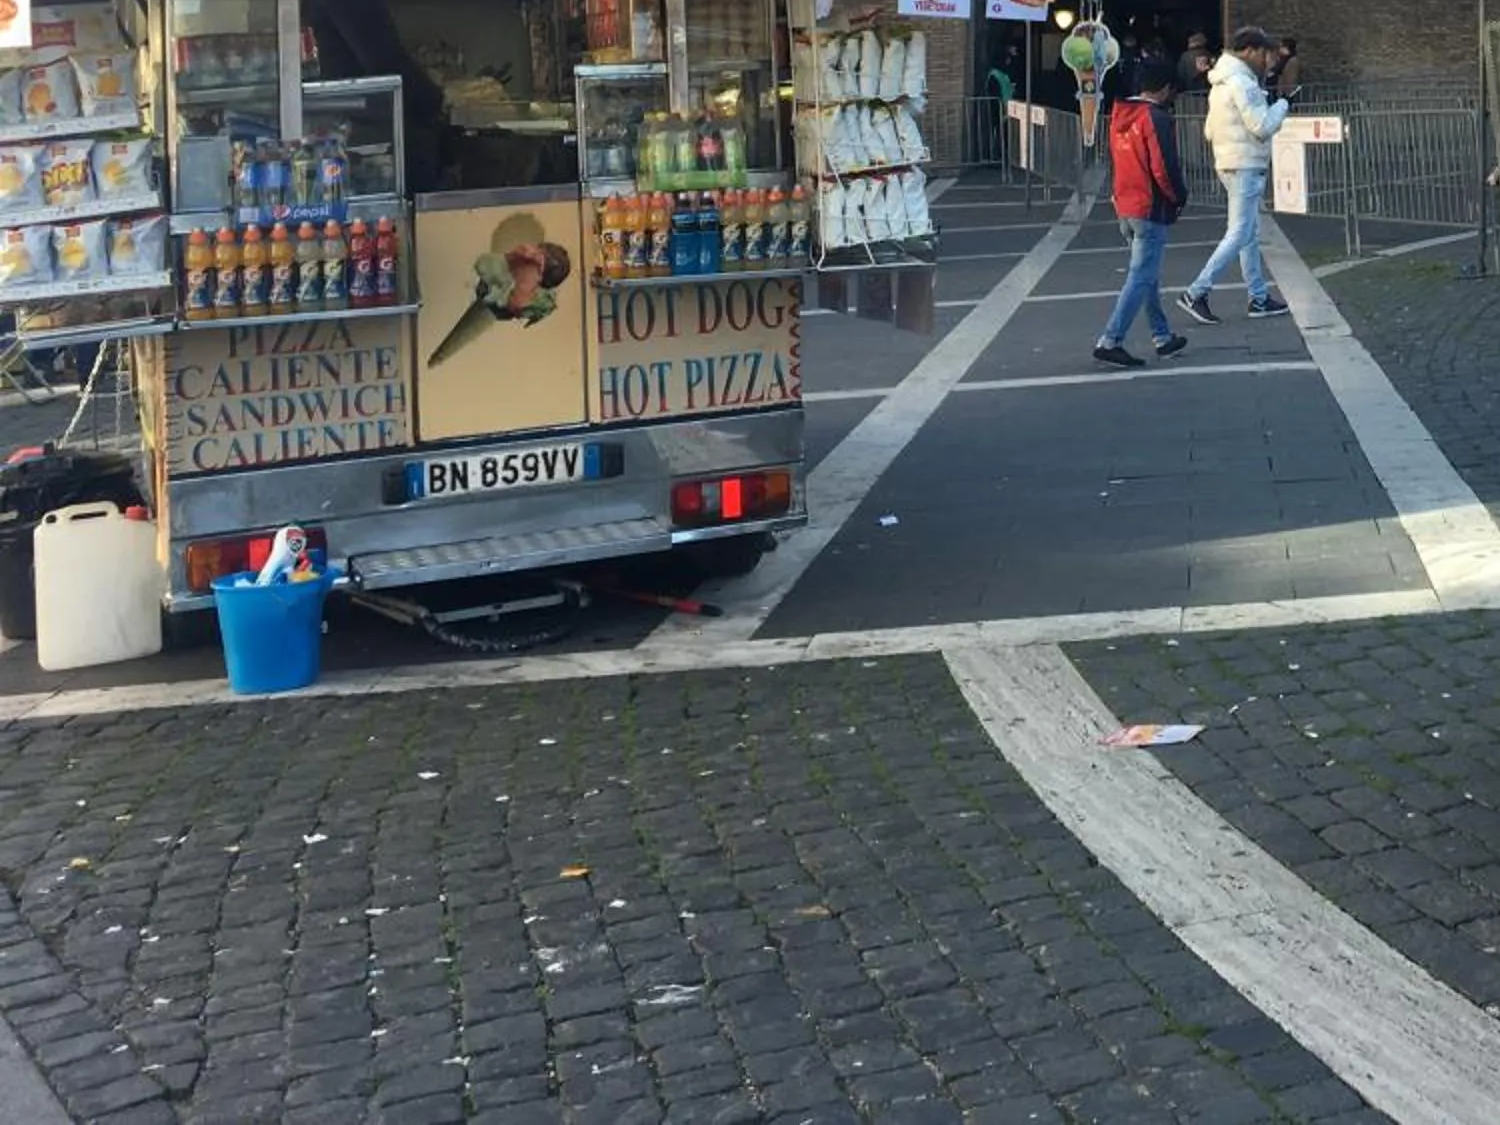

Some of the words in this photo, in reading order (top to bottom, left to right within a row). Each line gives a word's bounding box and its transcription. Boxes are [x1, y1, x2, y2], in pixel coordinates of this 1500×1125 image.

[293, 206, 330, 220] pepsi
[597, 283, 683, 344] HOT
[696, 277, 785, 334] DOG
[226, 319, 357, 359] PIZZA
[175, 346, 400, 401] CALIENTE
[599, 360, 673, 420] HOT
[684, 350, 790, 410] PIZZA
[187, 381, 407, 437] SANDWICH
[192, 418, 399, 472] CALIENTE
[429, 459, 469, 494] BN
[479, 446, 579, 488] 859VV
